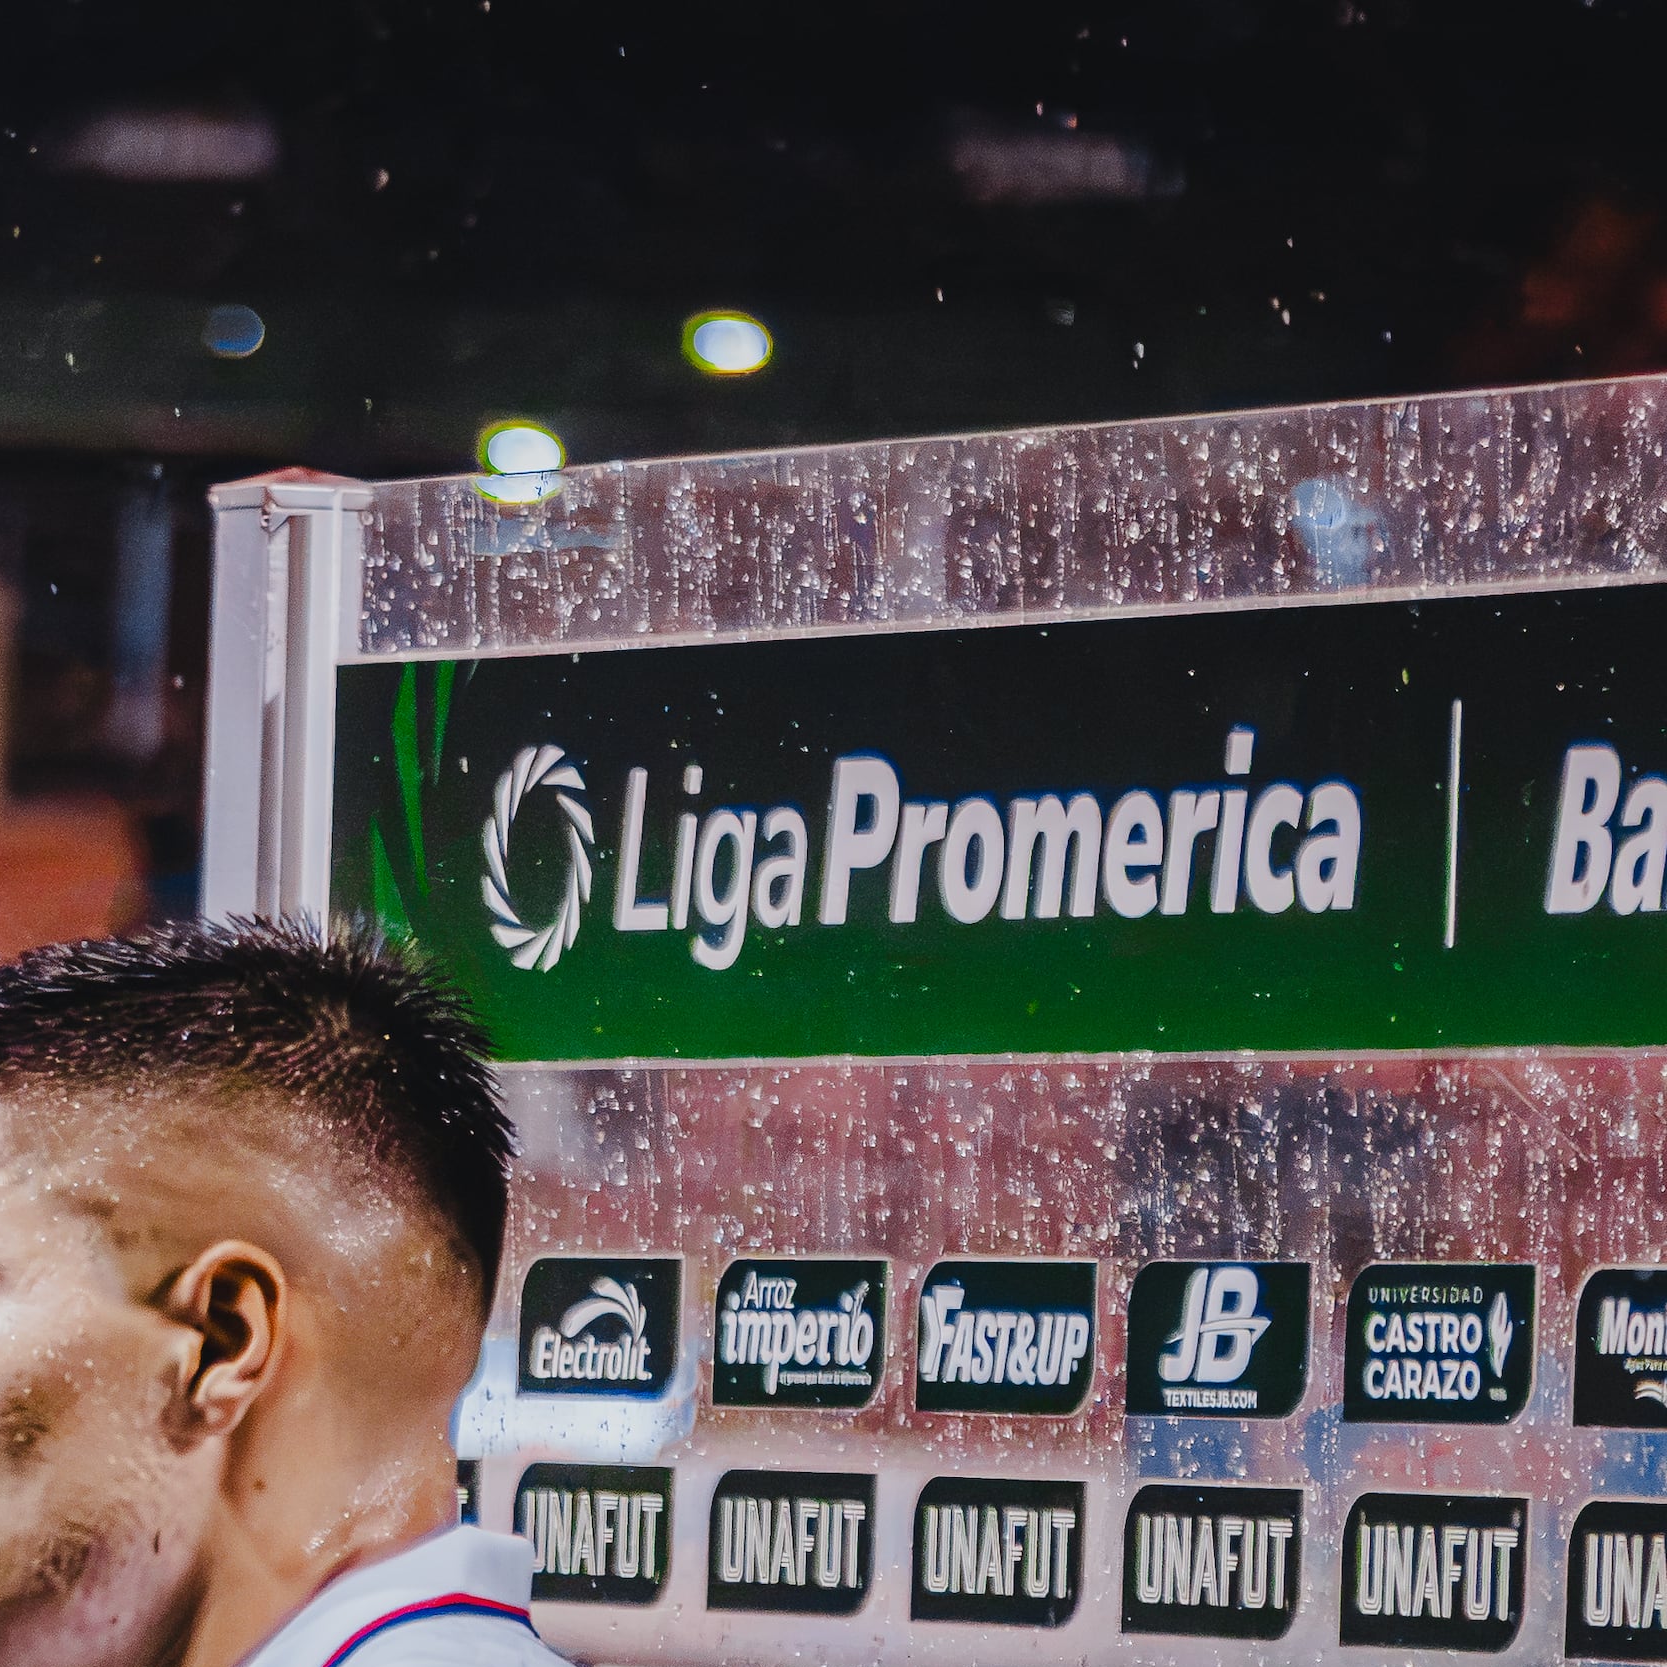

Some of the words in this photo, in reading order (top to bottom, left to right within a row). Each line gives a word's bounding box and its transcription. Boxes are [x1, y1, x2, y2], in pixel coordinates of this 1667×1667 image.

[614, 765, 807, 972] Liga
[817, 725, 1362, 927] Promerica
[741, 1271, 798, 1309] Arroz
[919, 1284, 1089, 1386] FAST&UP
[1159, 1267, 1265, 1383] JB
[1364, 1312, 1483, 1354] CASTRO
[1369, 1285, 1484, 1304] UNIVERSIDAD
[1597, 1297, 1667, 1356] Mon
[532, 1328, 653, 1381] Electrolit
[721, 1280, 874, 1396] imperio
[1364, 1359, 1481, 1401] CARAZO
[1163, 1388, 1258, 1410] TEXTILESJB.COM
[529, 1489, 663, 1579] UNAFUT
[720, 1499, 865, 1589] UNAFUT
[922, 1506, 1077, 1600] UNAFUT
[1137, 1514, 1293, 1610] UNAFUT
[1359, 1524, 1518, 1621] UNAFUT
